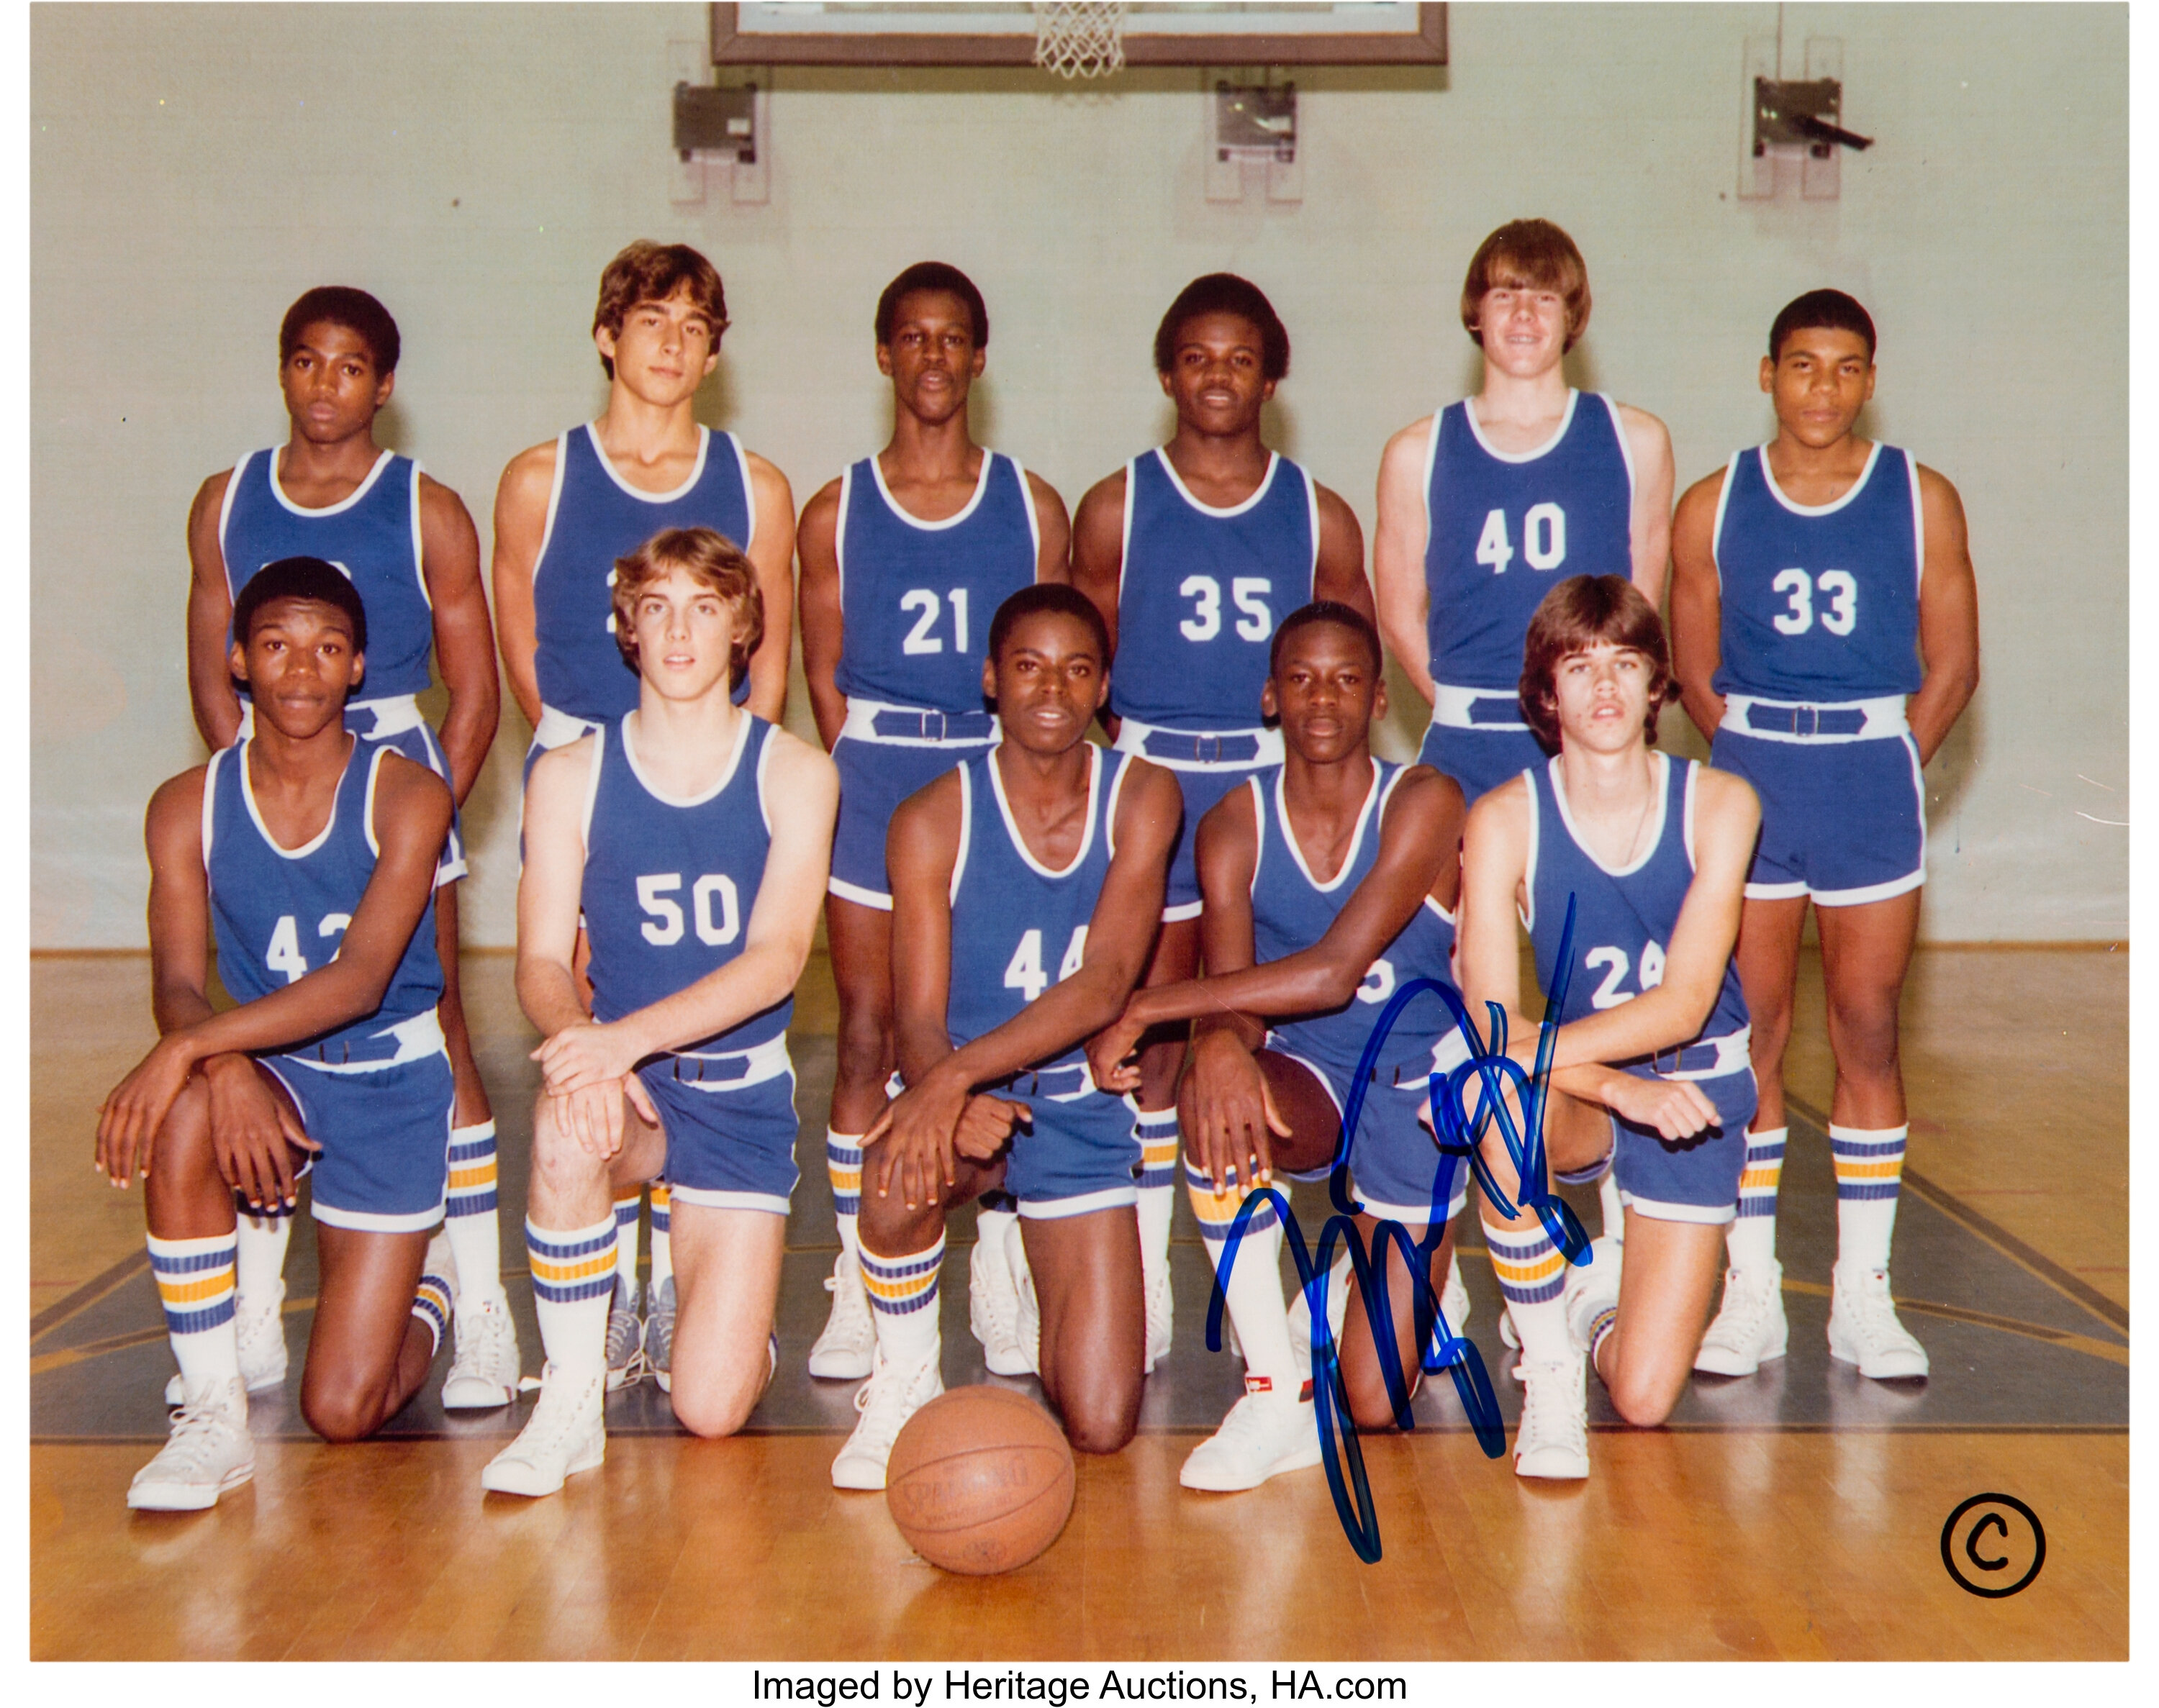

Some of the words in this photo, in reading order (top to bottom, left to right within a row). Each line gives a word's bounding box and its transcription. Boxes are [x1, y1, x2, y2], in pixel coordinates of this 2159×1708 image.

[1475, 502, 1566, 574] 40
[900, 588, 969, 655] 21
[1180, 575, 1272, 642] 35
[1773, 568, 1857, 636] 33
[635, 872, 741, 947] 50
[1356, 958, 1395, 1004] 5
[903, 1454, 1029, 1517] SPALNG
